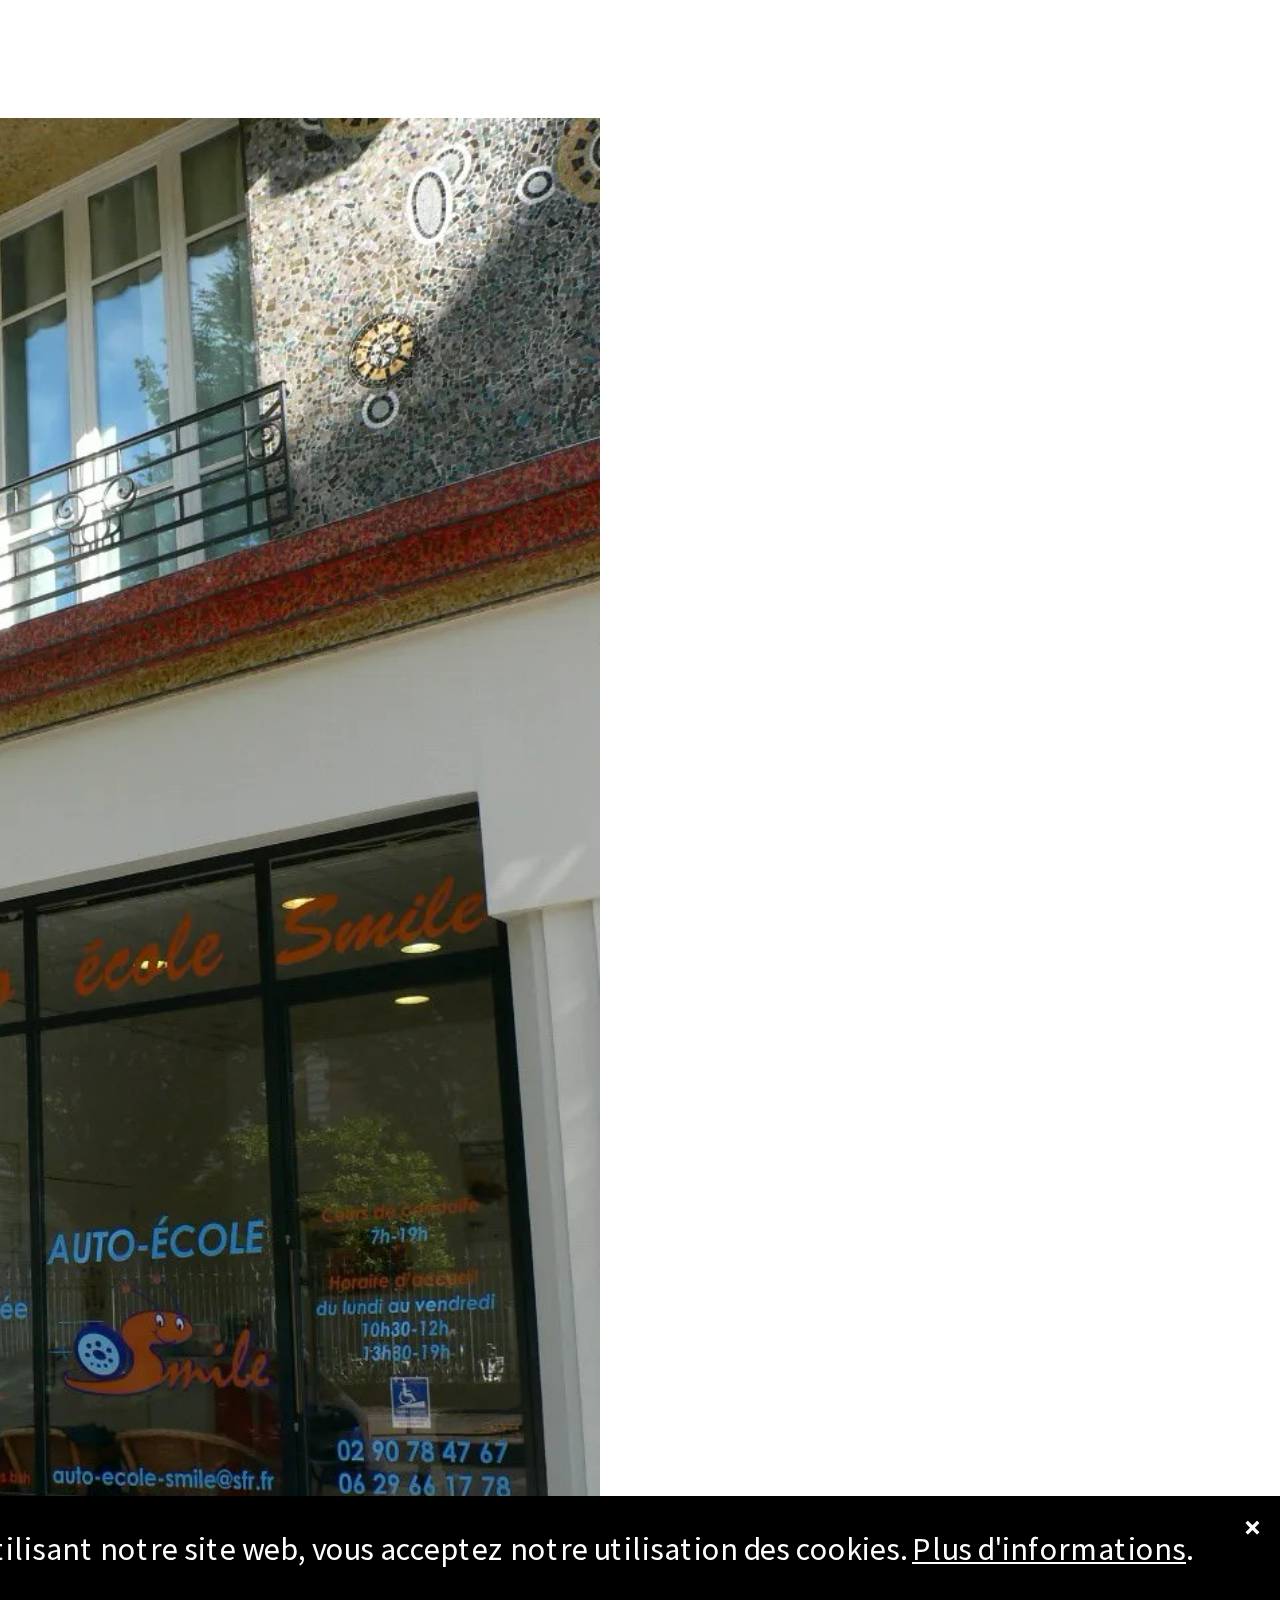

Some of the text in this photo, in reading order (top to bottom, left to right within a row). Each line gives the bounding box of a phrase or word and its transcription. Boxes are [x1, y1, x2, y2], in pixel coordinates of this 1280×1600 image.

[74, 912, 224, 997] école
[276, 876, 488, 966] Smile
[47, 1214, 265, 1266] AUTO-ÉCOLE
[371, 1225, 428, 1245] 7h-19h
[329, 1274, 389, 1290] Horaire
[316, 1294, 496, 1316] du lundi au vendredi
[362, 1320, 450, 1338] 10h30-12h
[363, 1343, 451, 1362] 13h30-19h
[337, 1439, 509, 1464] 02 90 78 47 67
[52, 1464, 275, 1492] auto-ecole-smile@sfr.fr
[338, 1471, 511, 1496] 06 29 66 17 78
[102, 1538, 178, 1561] notre
[184, 1536, 236, 1561] site
[242, 1536, 305, 1566] web,
[311, 1543, 374, 1561] vous
[381, 1538, 502, 1568] acceptez
[512, 1538, 588, 1561] notre
[595, 1536, 737, 1561] utilisation
[744, 1536, 790, 1561] des
[796, 1536, 907, 1561] cookies.
[912, 1536, 972, 1562] Plus
[977, 1535, 1194, 1562] d'informations.
